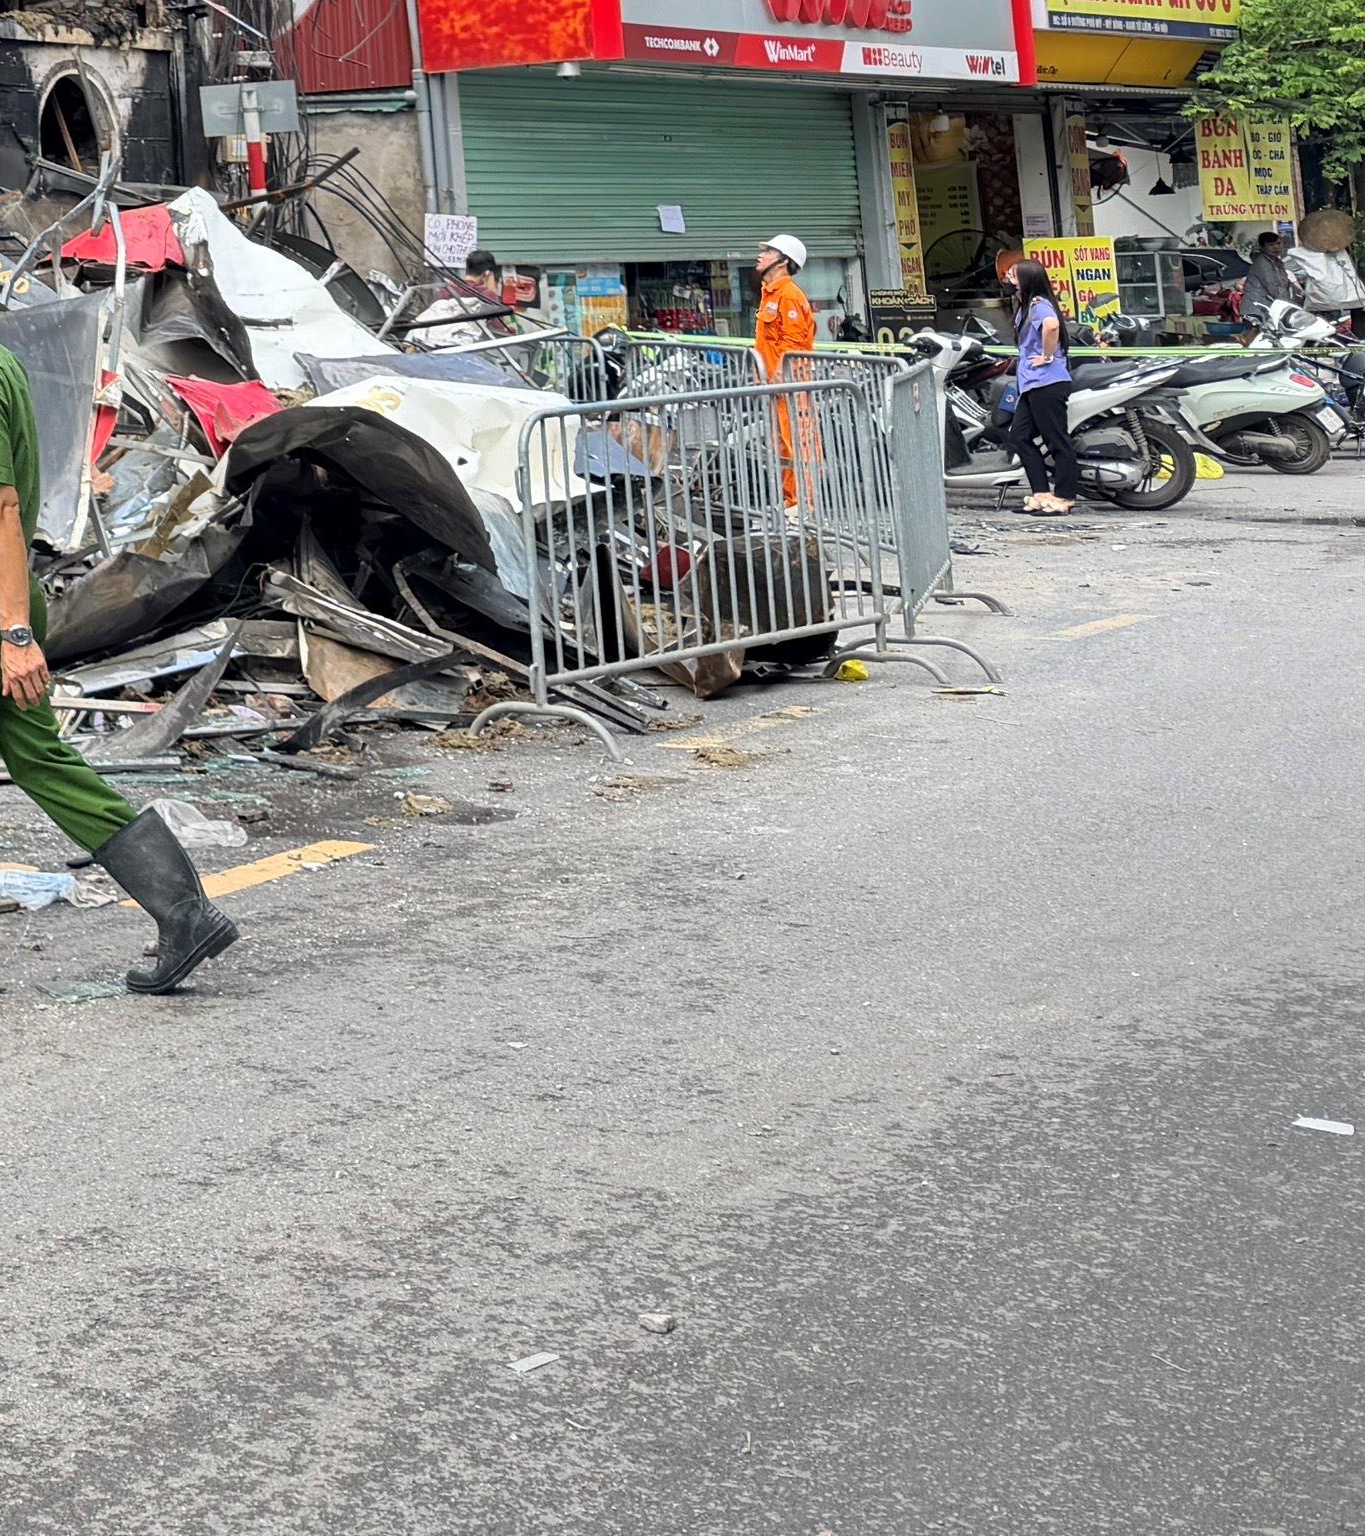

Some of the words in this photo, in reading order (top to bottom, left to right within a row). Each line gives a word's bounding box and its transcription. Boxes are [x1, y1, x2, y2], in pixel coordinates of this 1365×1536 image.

[644, 36, 702, 52] TECHCOMBANK
[1201, 144, 1244, 169] BÁNH
[1213, 177, 1237, 196] ĐA
[1209, 201, 1247, 216] TRỨNG
[1249, 203, 1266, 217] VỊT
[1076, 268, 1111, 281] NGAN
